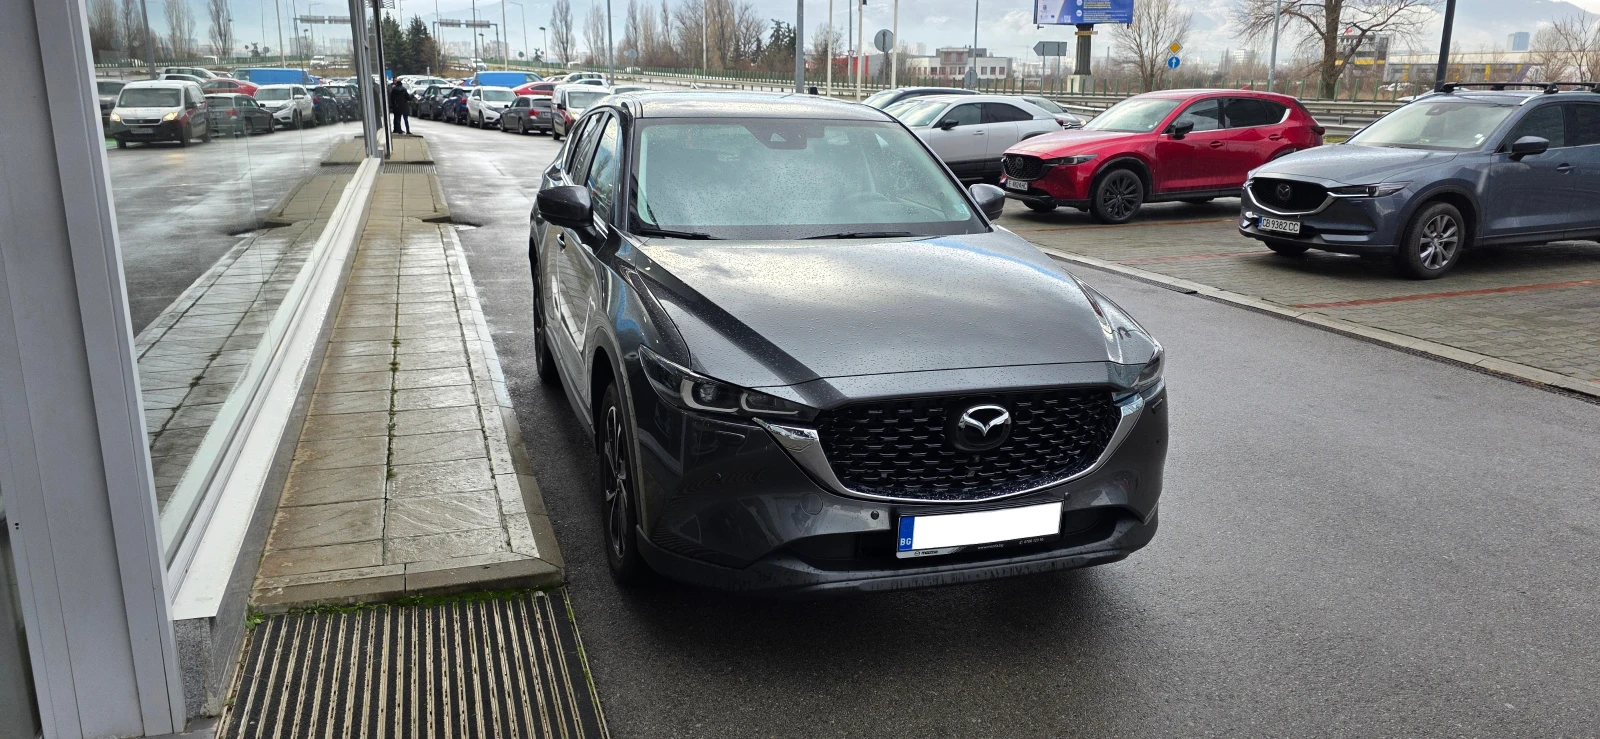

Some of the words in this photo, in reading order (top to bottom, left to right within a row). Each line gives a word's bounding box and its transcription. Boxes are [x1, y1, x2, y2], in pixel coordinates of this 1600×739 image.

[1262, 218, 1271, 228] CB
[1271, 219, 1288, 231] 9382
[1288, 222, 1299, 232] CC
[900, 537, 912, 546] BG
